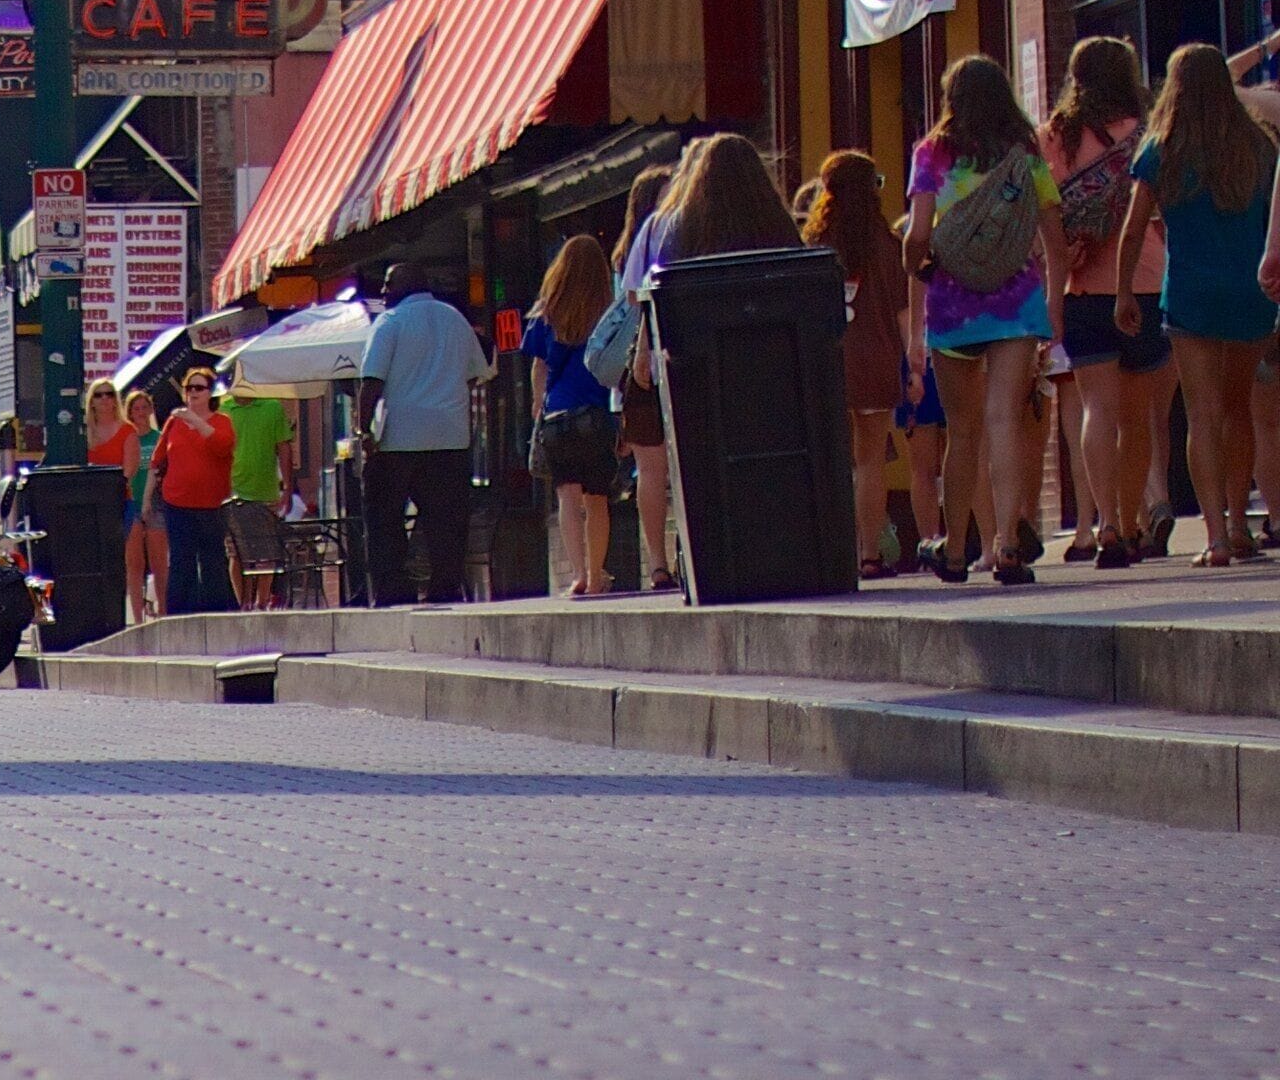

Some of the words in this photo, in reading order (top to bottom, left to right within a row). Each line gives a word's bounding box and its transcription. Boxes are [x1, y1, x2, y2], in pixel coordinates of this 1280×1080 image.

[83, 70, 118, 89] AIR
[43, 175, 74, 192] NO
[39, 199, 79, 209] PARKING
[39, 214, 82, 224] STANDING
[125, 215, 154, 226] RAW
[125, 230, 182, 241] OYSTERS
[126, 245, 183, 256] SHRIMP
[127, 274, 181, 284] CHICKEN
[128, 286, 181, 296] NACHOS
[198, 326, 232, 345] Coors
